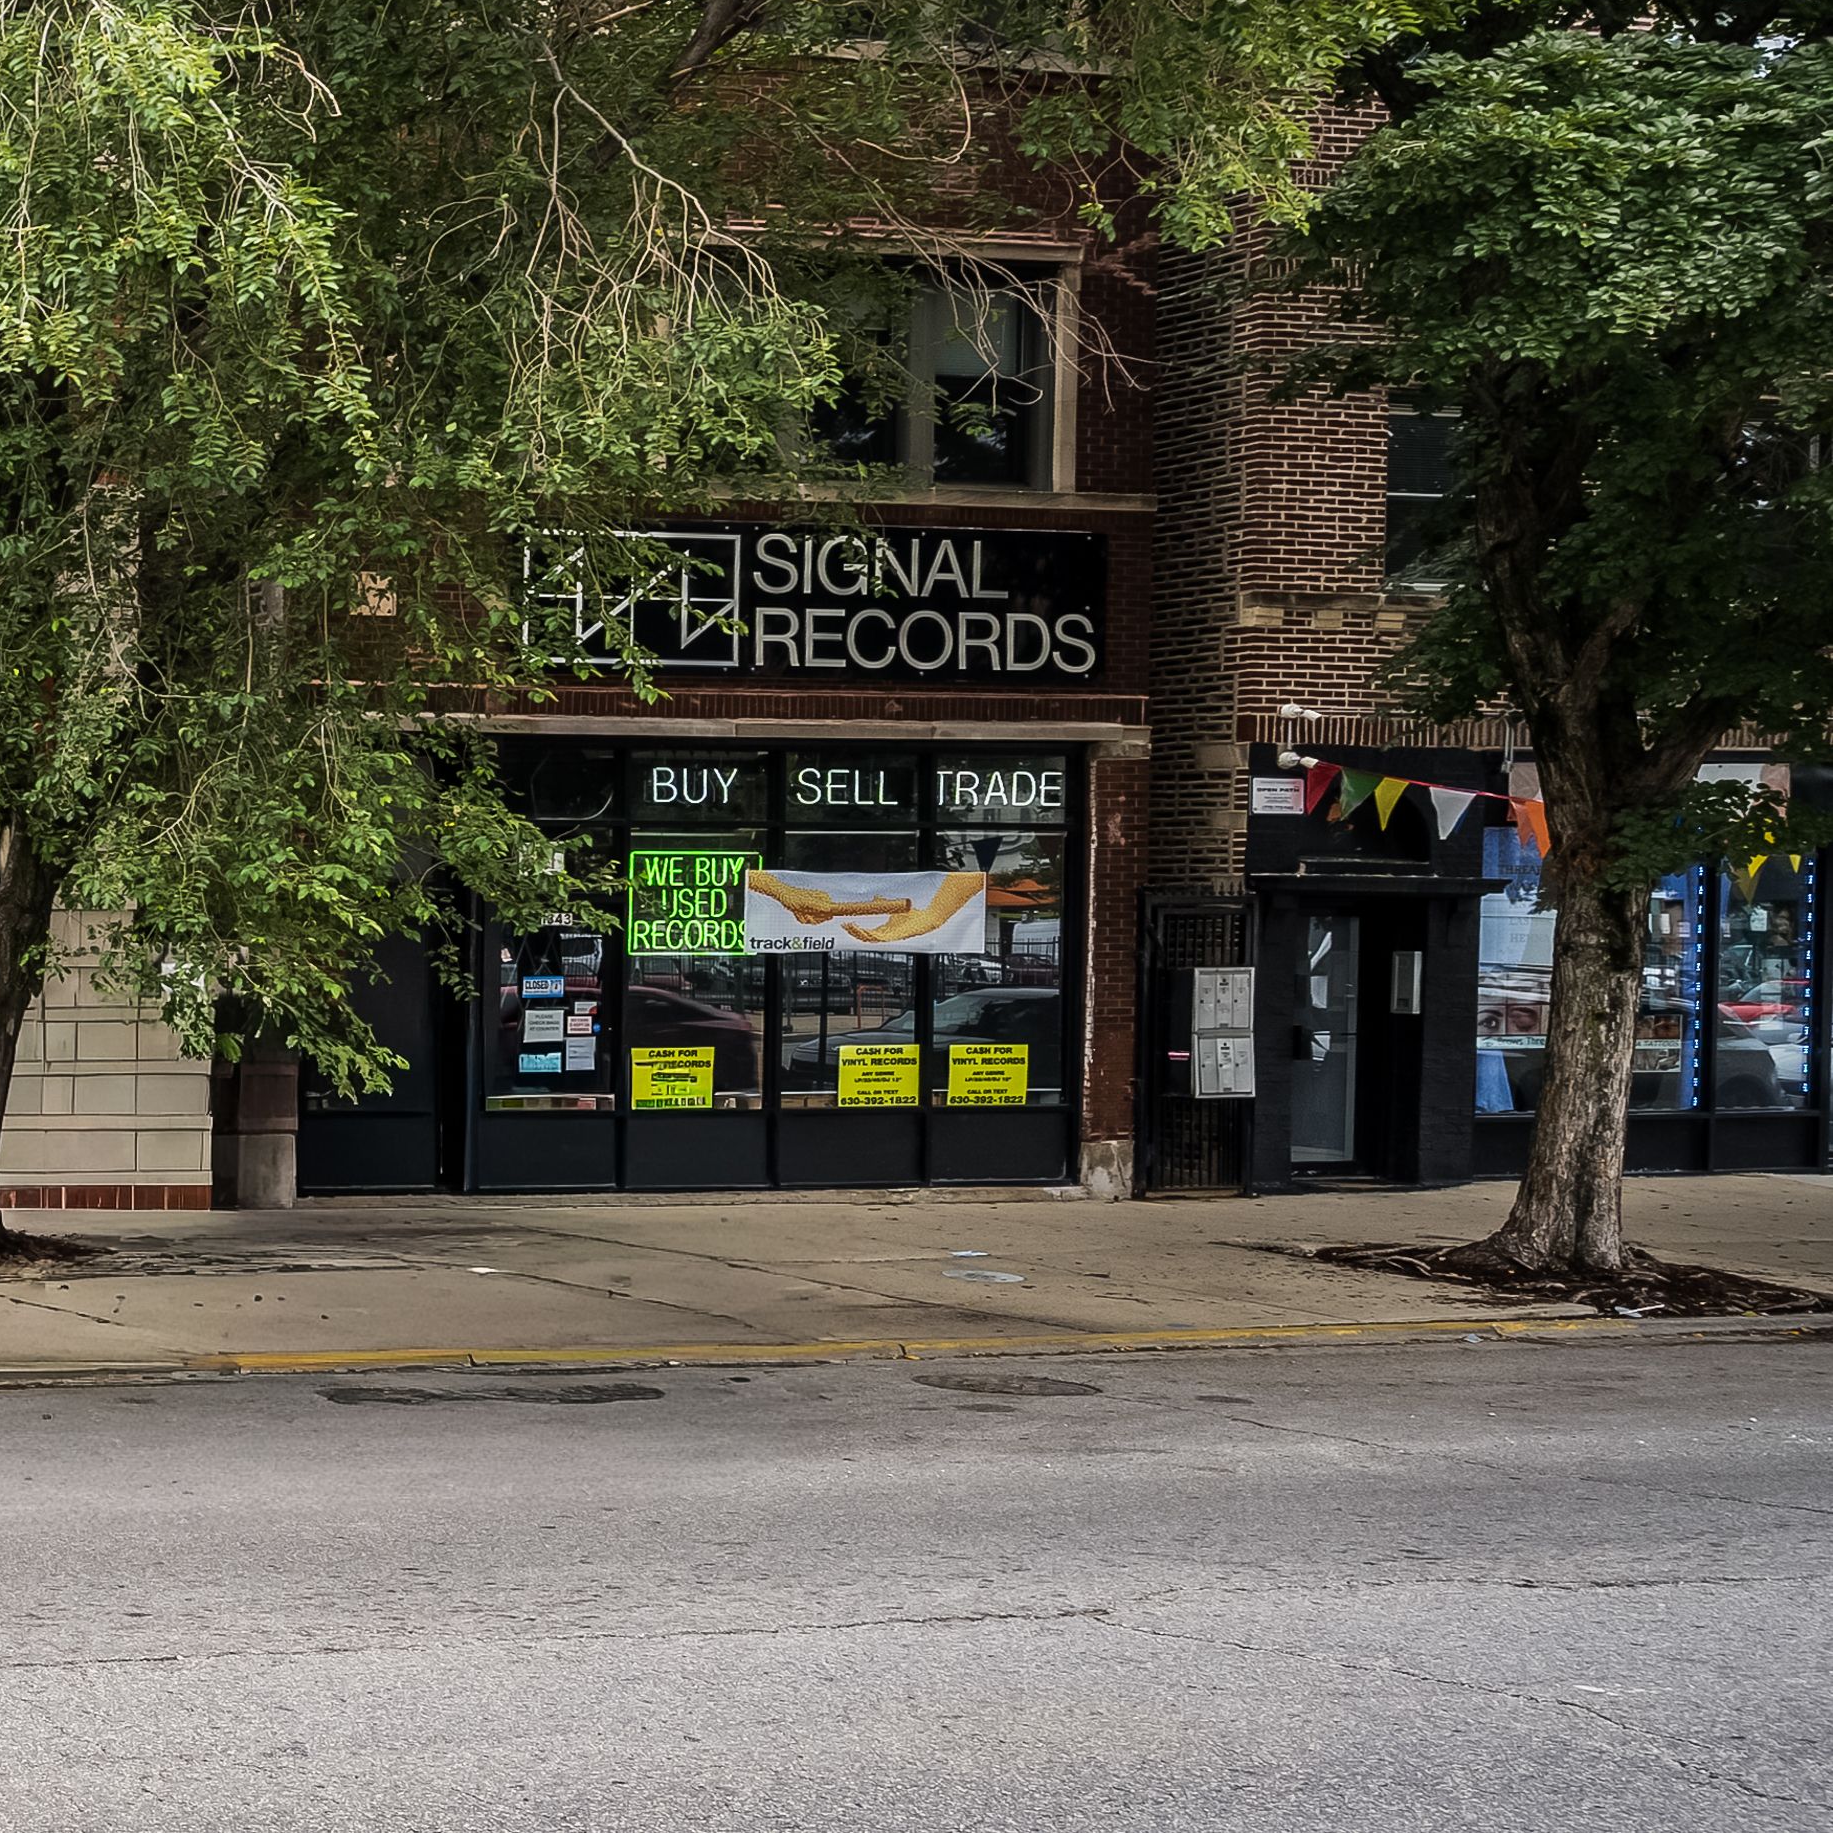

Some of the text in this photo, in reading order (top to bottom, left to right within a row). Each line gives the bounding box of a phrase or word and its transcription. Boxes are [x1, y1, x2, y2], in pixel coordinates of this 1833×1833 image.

[753, 533, 1009, 599] SIGNAL
[755, 607, 1096, 673] RECORDS
[652, 767, 1063, 807] BUY SELL TRADE
[645, 857, 744, 886] WE BUY
[662, 889, 727, 918] USED
[543, 914, 571, 925] 1343
[633, 920, 746, 950] RECORDS
[749, 936, 835, 950] track&field
[525, 980, 549, 989] CLOSED
[856, 1047, 903, 1055] CASH FOR
[841, 1057, 917, 1066] VINYL RECORDS
[981, 1057, 1026, 1065] RECORDS
[840, 1096, 917, 1105] 630-392-1822
[949, 1096, 1024, 1104] 630-392-1822
